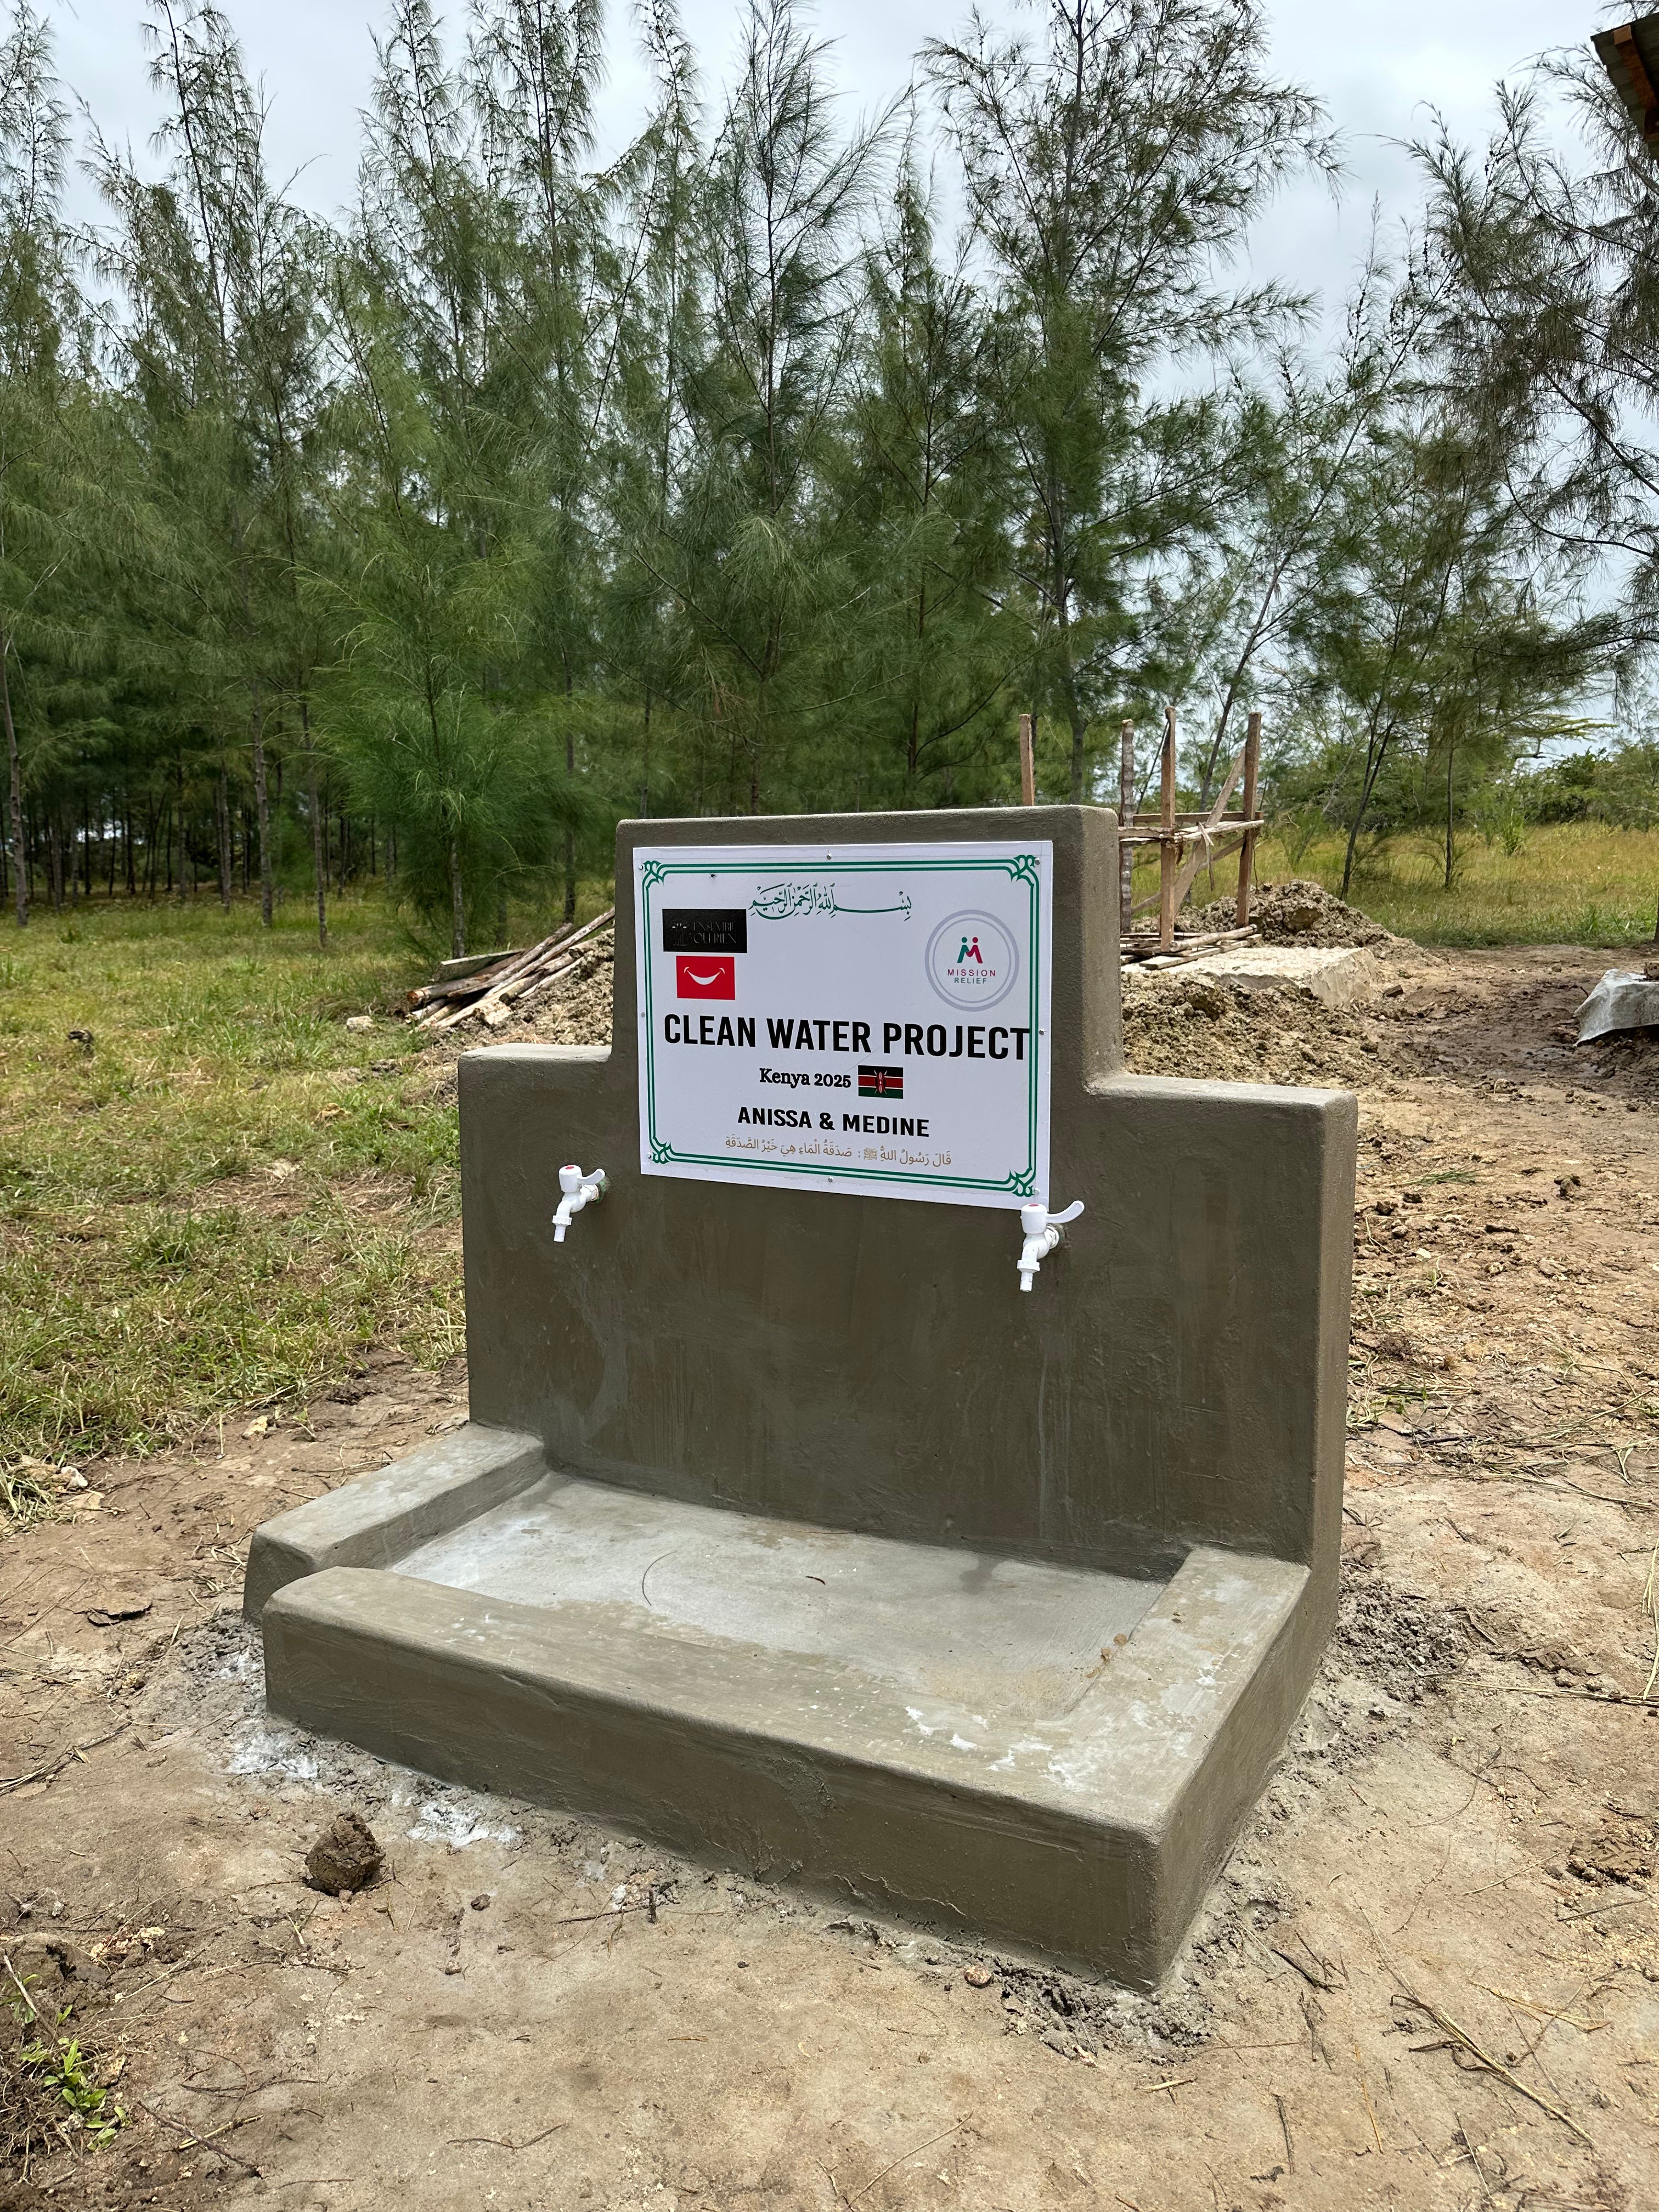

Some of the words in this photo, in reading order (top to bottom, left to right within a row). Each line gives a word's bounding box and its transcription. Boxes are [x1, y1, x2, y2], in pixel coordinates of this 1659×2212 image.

[947, 969, 996, 977] MISSION
[664, 1013, 757, 1048] CLEAN
[765, 1018, 872, 1054] WATER
[883, 1022, 1030, 1061] PROJECT
[759, 1067, 811, 1089] Kenya
[813, 1072, 852, 1089] 2025
[737, 1107, 812, 1129] ANISSA
[819, 1111, 836, 1131] &
[843, 1113, 929, 1138] MEDINE
